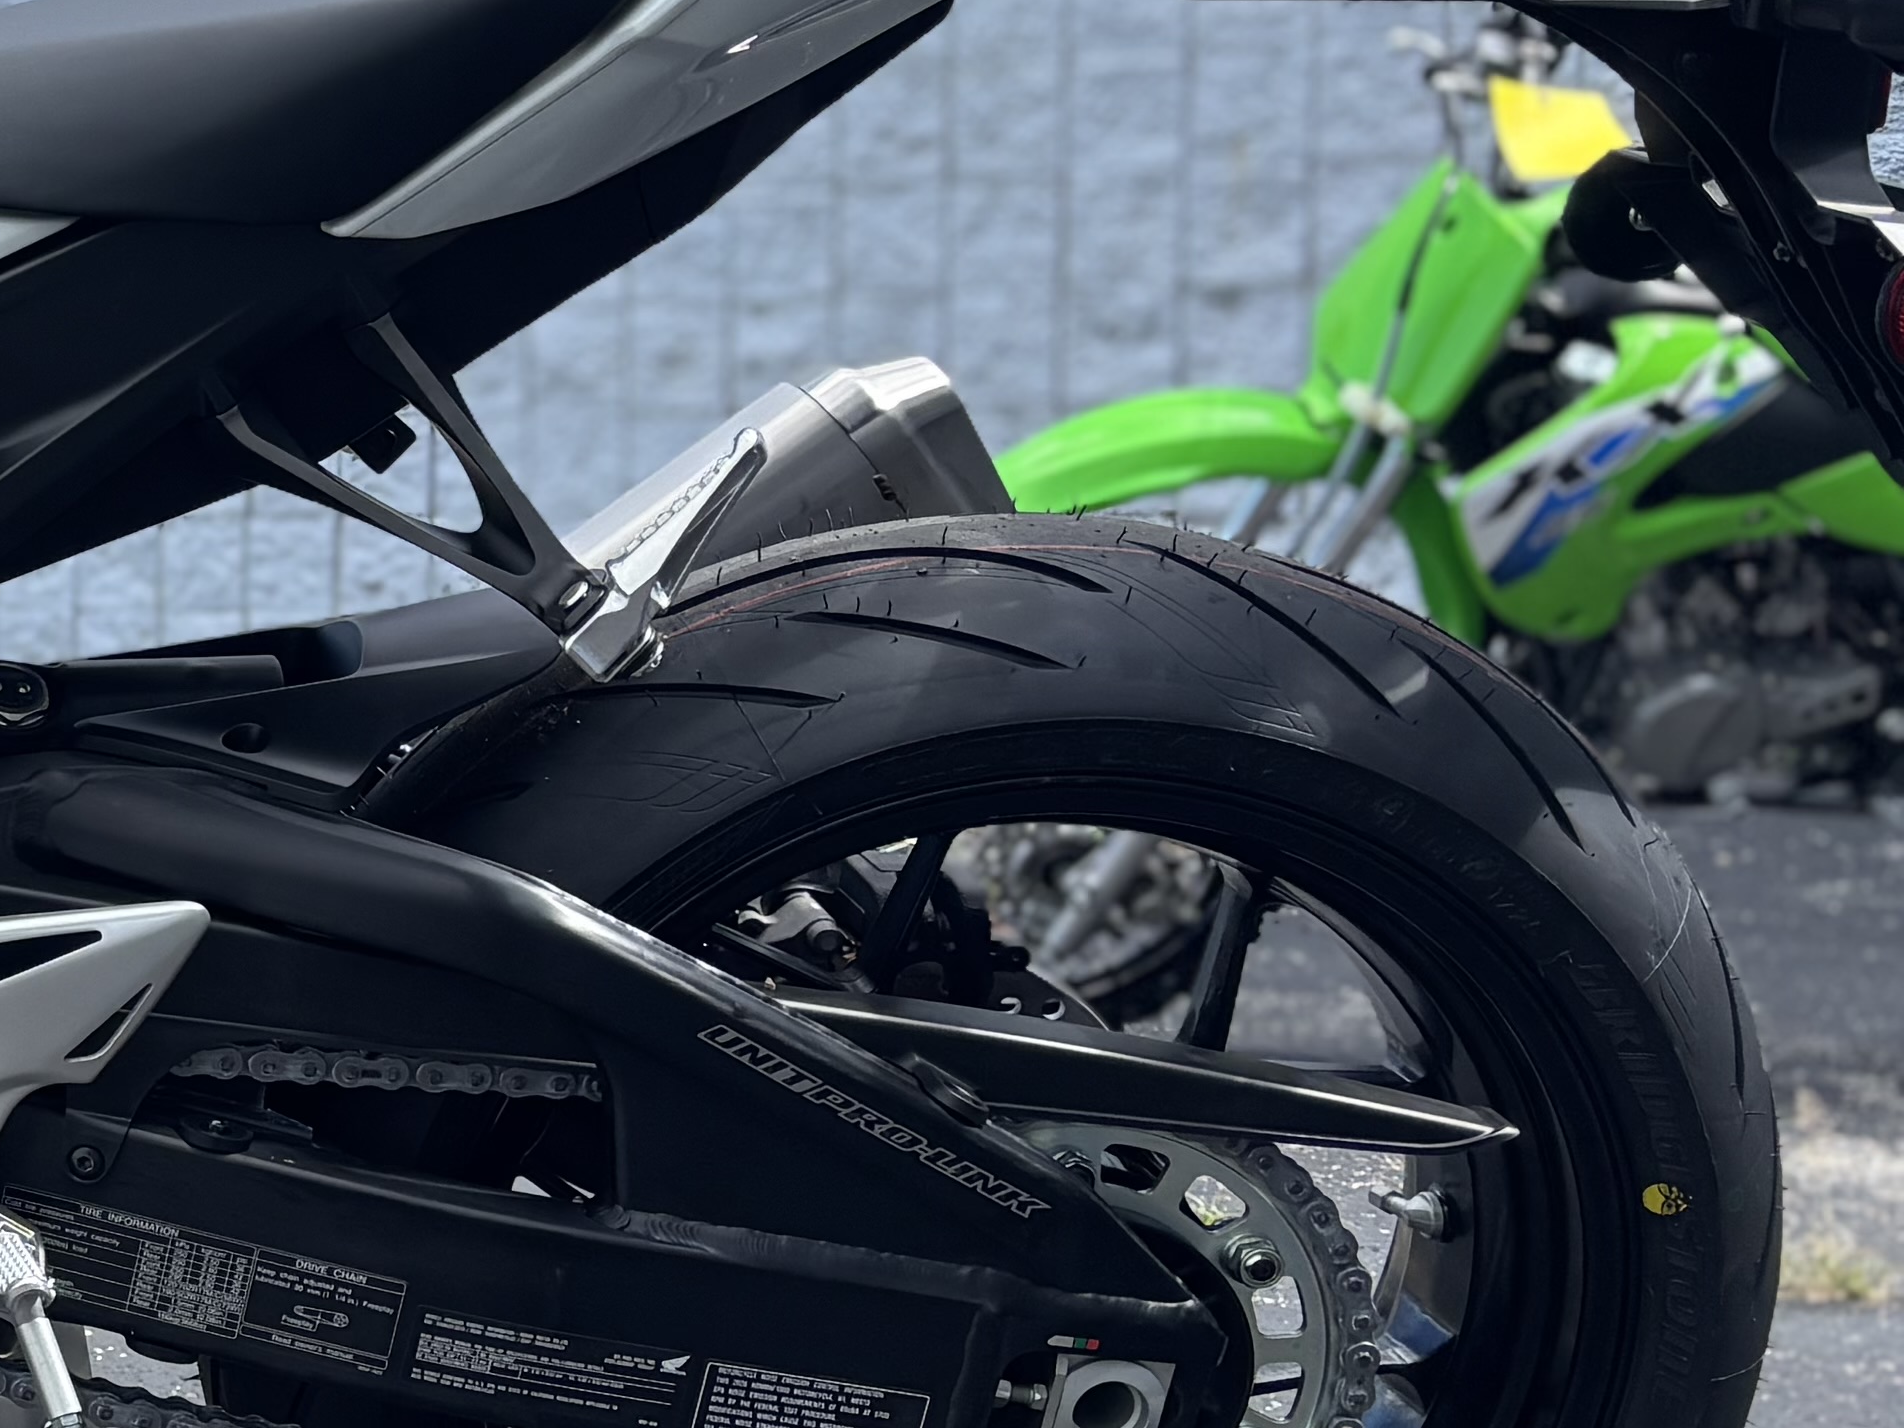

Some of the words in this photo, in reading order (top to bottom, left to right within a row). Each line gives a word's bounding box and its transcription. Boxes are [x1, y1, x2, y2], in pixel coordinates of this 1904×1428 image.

[697, 1024, 824, 1094] UNIT
[807, 1086, 1050, 1218] PRO-LINK
[80, 1205, 103, 1219] TIRE
[108, 1213, 180, 1237] INFORMATION
[296, 1258, 328, 1275] DRIVE
[333, 1268, 368, 1285] CHAIN
